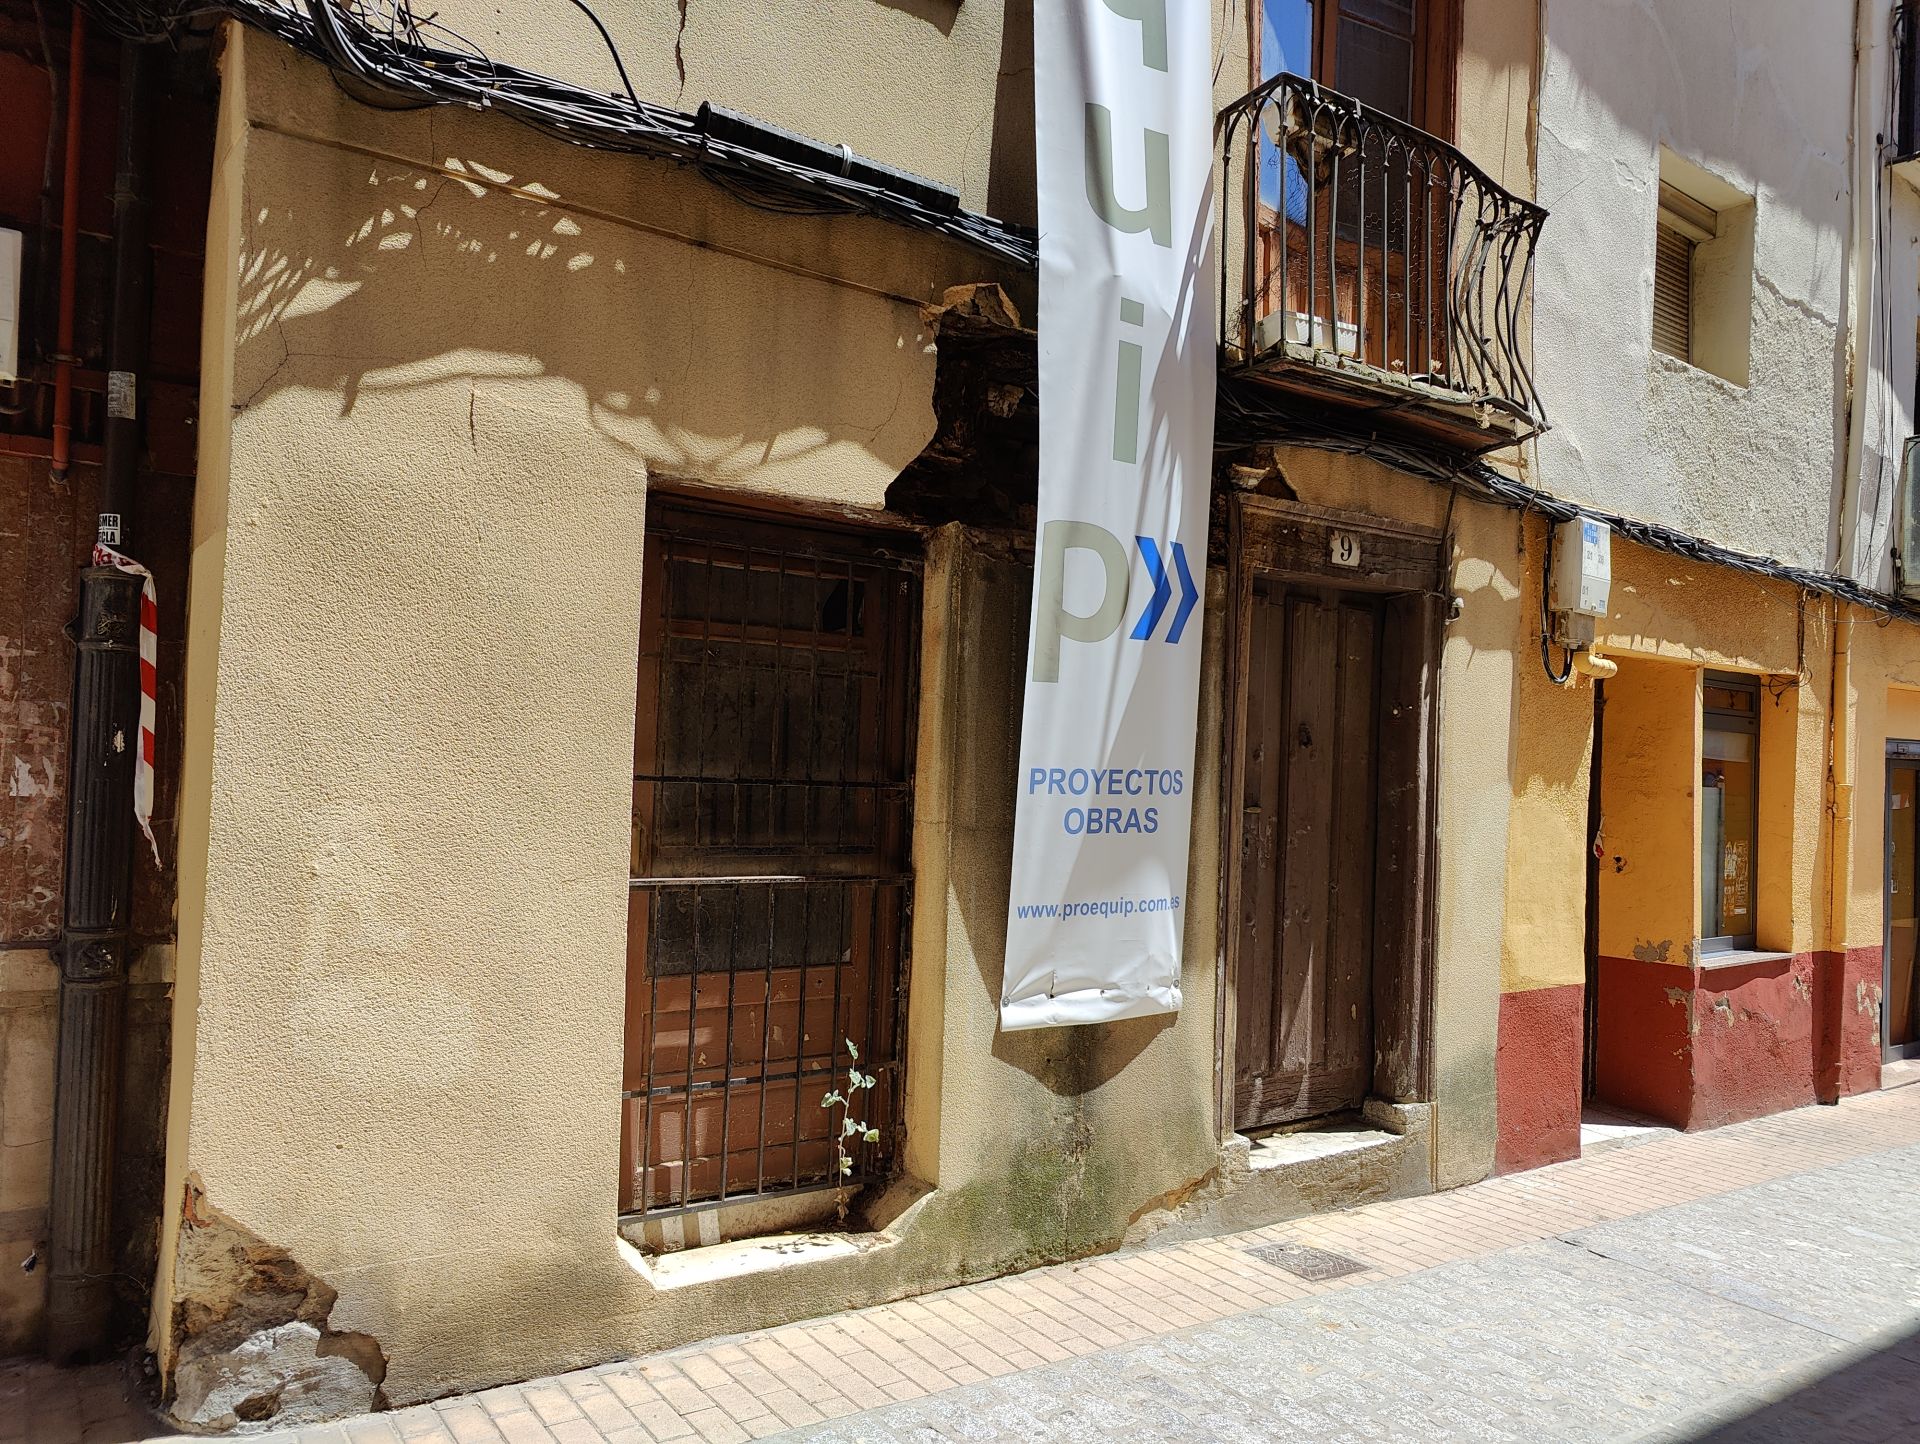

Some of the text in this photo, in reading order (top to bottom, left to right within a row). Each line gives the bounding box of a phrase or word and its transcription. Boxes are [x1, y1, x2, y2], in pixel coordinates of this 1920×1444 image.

[1340, 535, 1353, 562] 9
[1029, 768, 1183, 796] PROYECTOS
[1064, 807, 1159, 835] OBRAS
[1017, 896, 1180, 921] www.proequip.com.es
